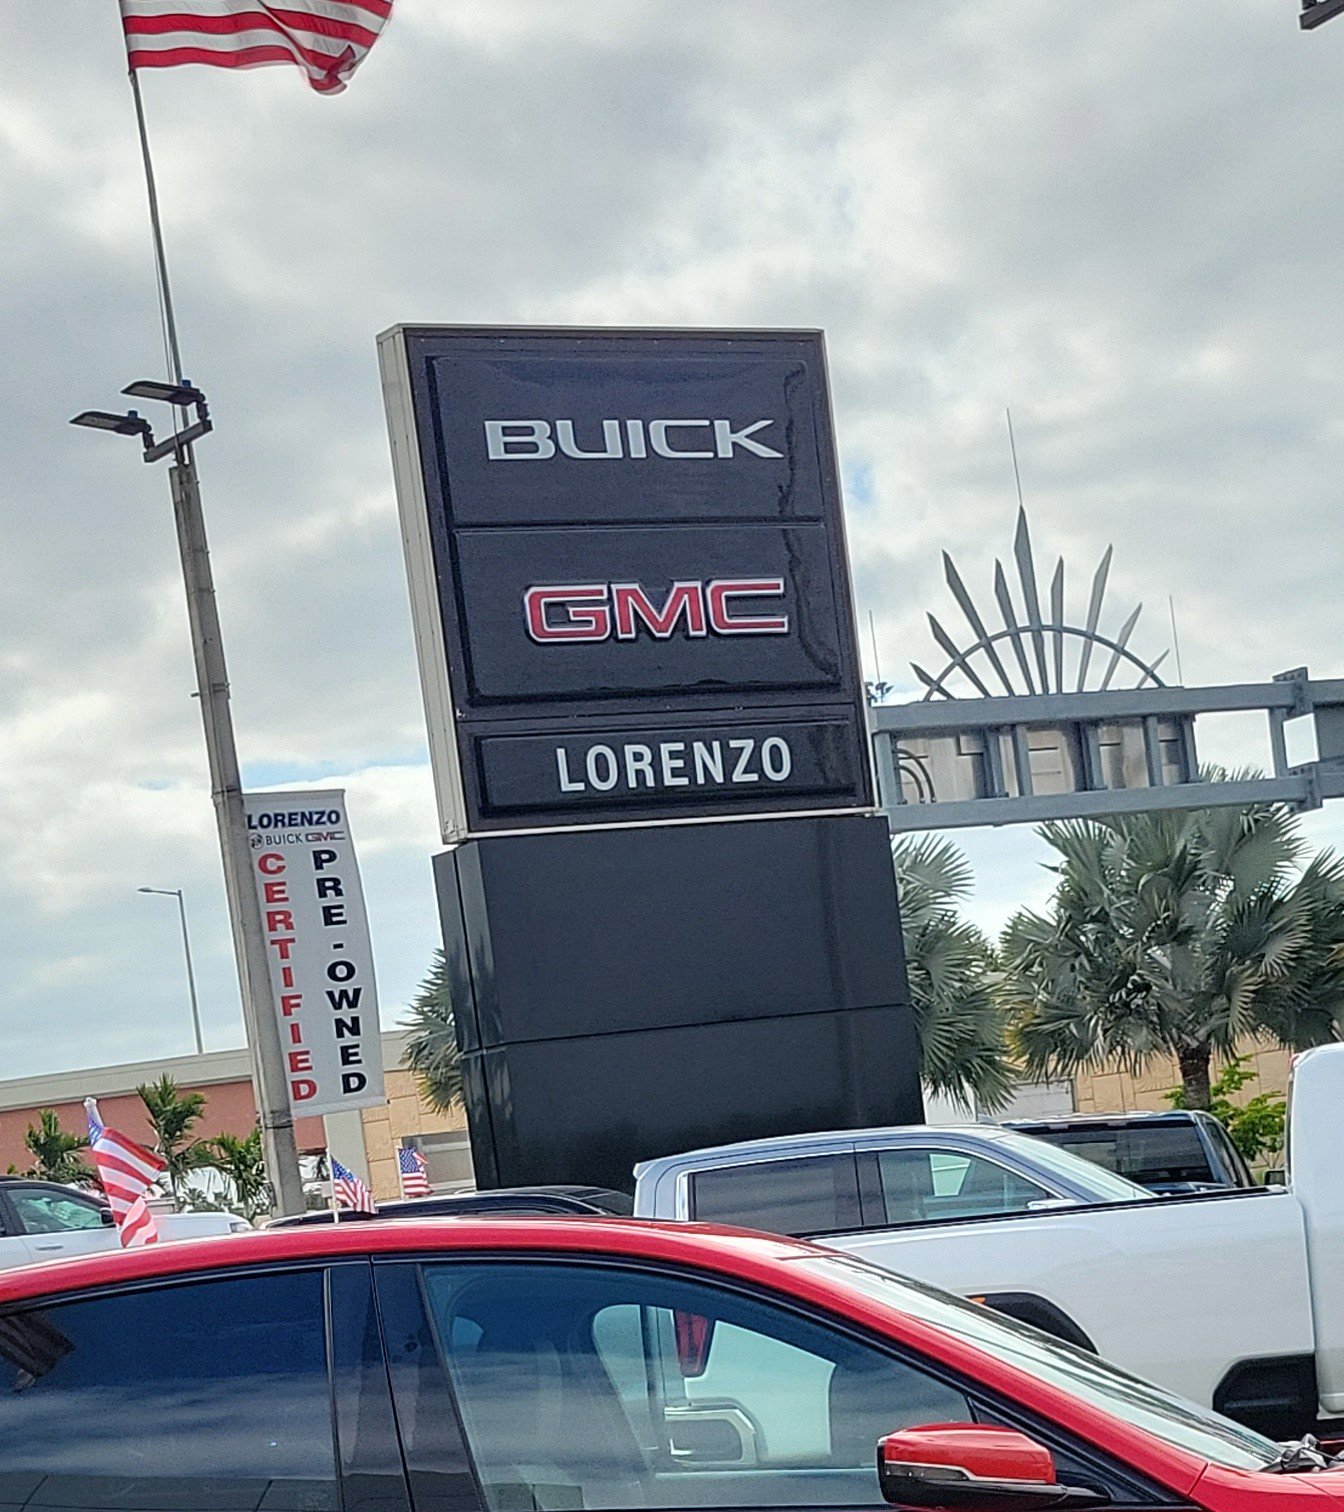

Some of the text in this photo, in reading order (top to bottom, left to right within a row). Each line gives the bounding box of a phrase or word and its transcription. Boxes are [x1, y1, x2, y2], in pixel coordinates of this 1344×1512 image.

[484, 419, 784, 460] BUICK
[524, 577, 788, 643] GMC
[556, 736, 792, 792] LORENZO
[247, 809, 341, 830] LORENZO
[265, 831, 346, 846] BUICK GMC
[258, 852, 318, 1101] CERTIFIED
[311, 849, 367, 1095] PRE-OWNED
